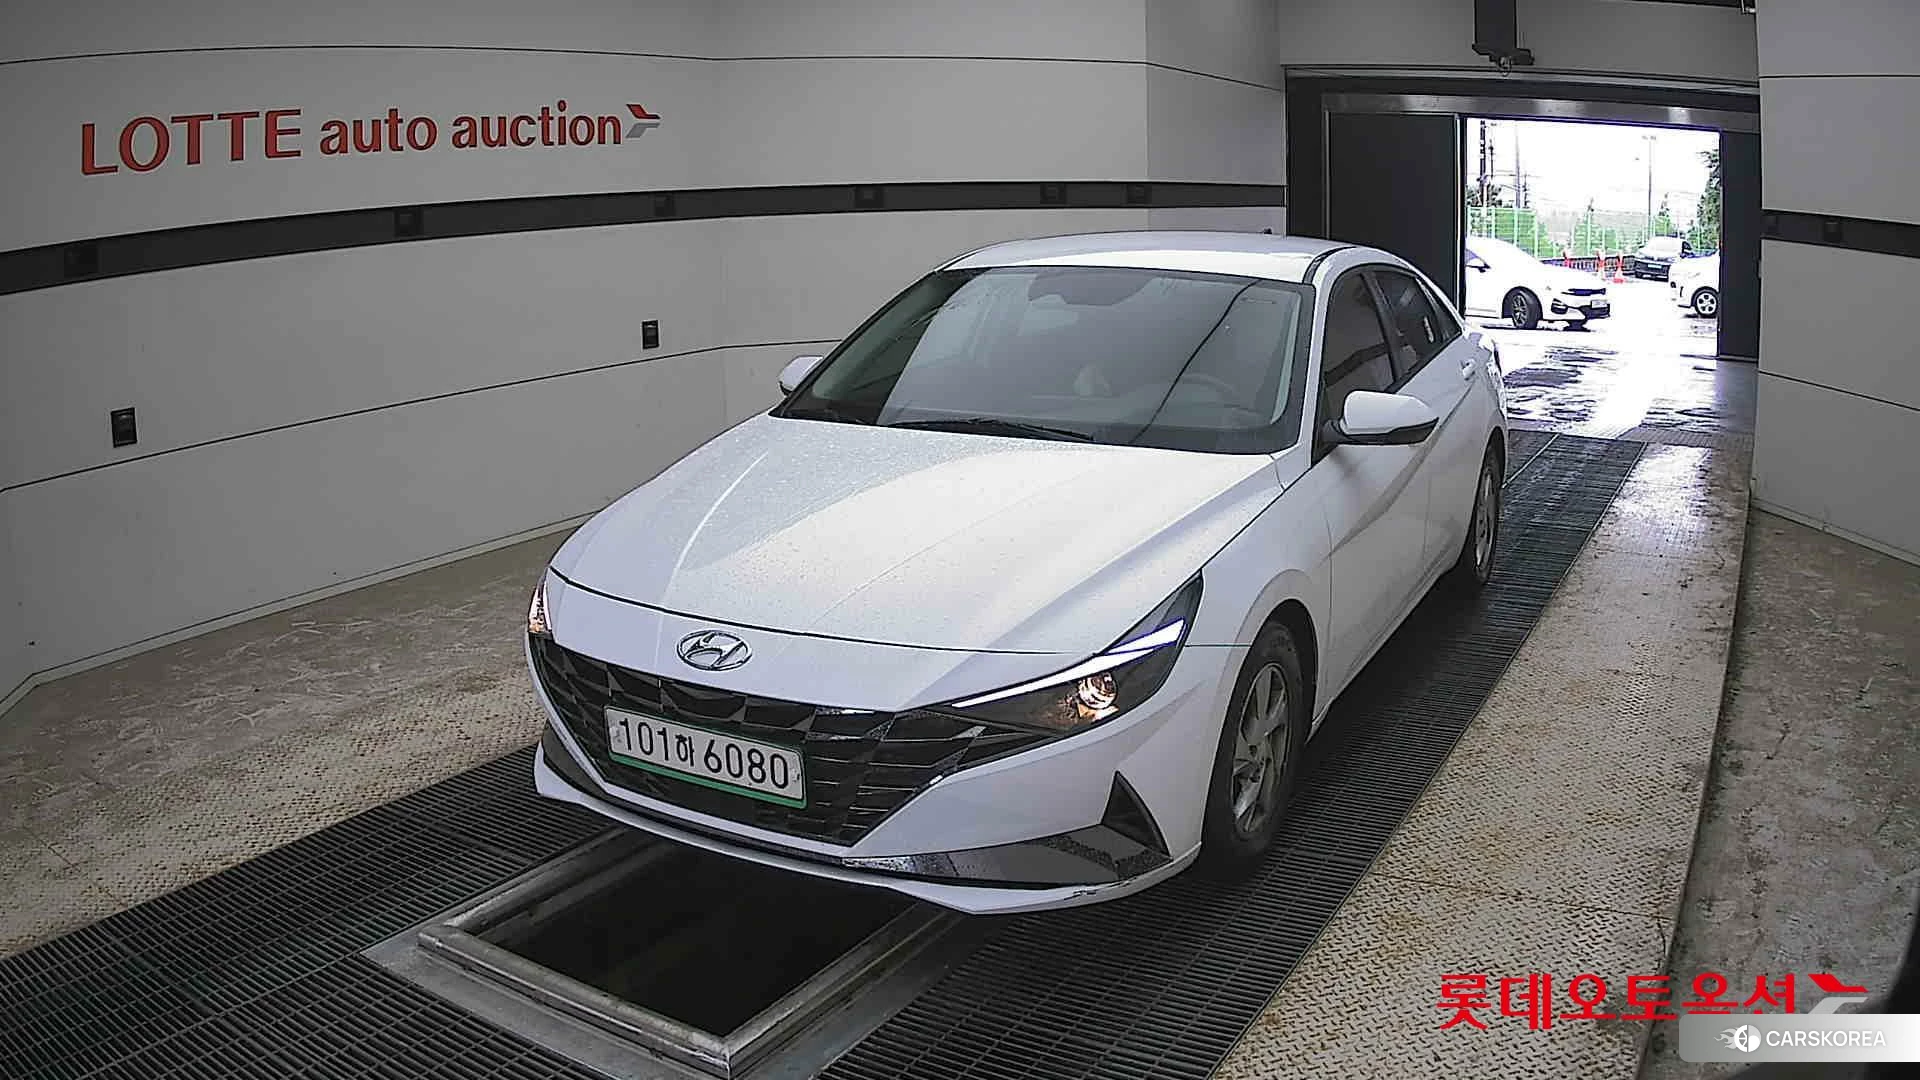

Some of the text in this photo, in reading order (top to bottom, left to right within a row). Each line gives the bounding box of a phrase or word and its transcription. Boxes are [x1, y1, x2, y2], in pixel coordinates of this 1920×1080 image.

[81, 100, 622, 176] LOTTE auto auction
